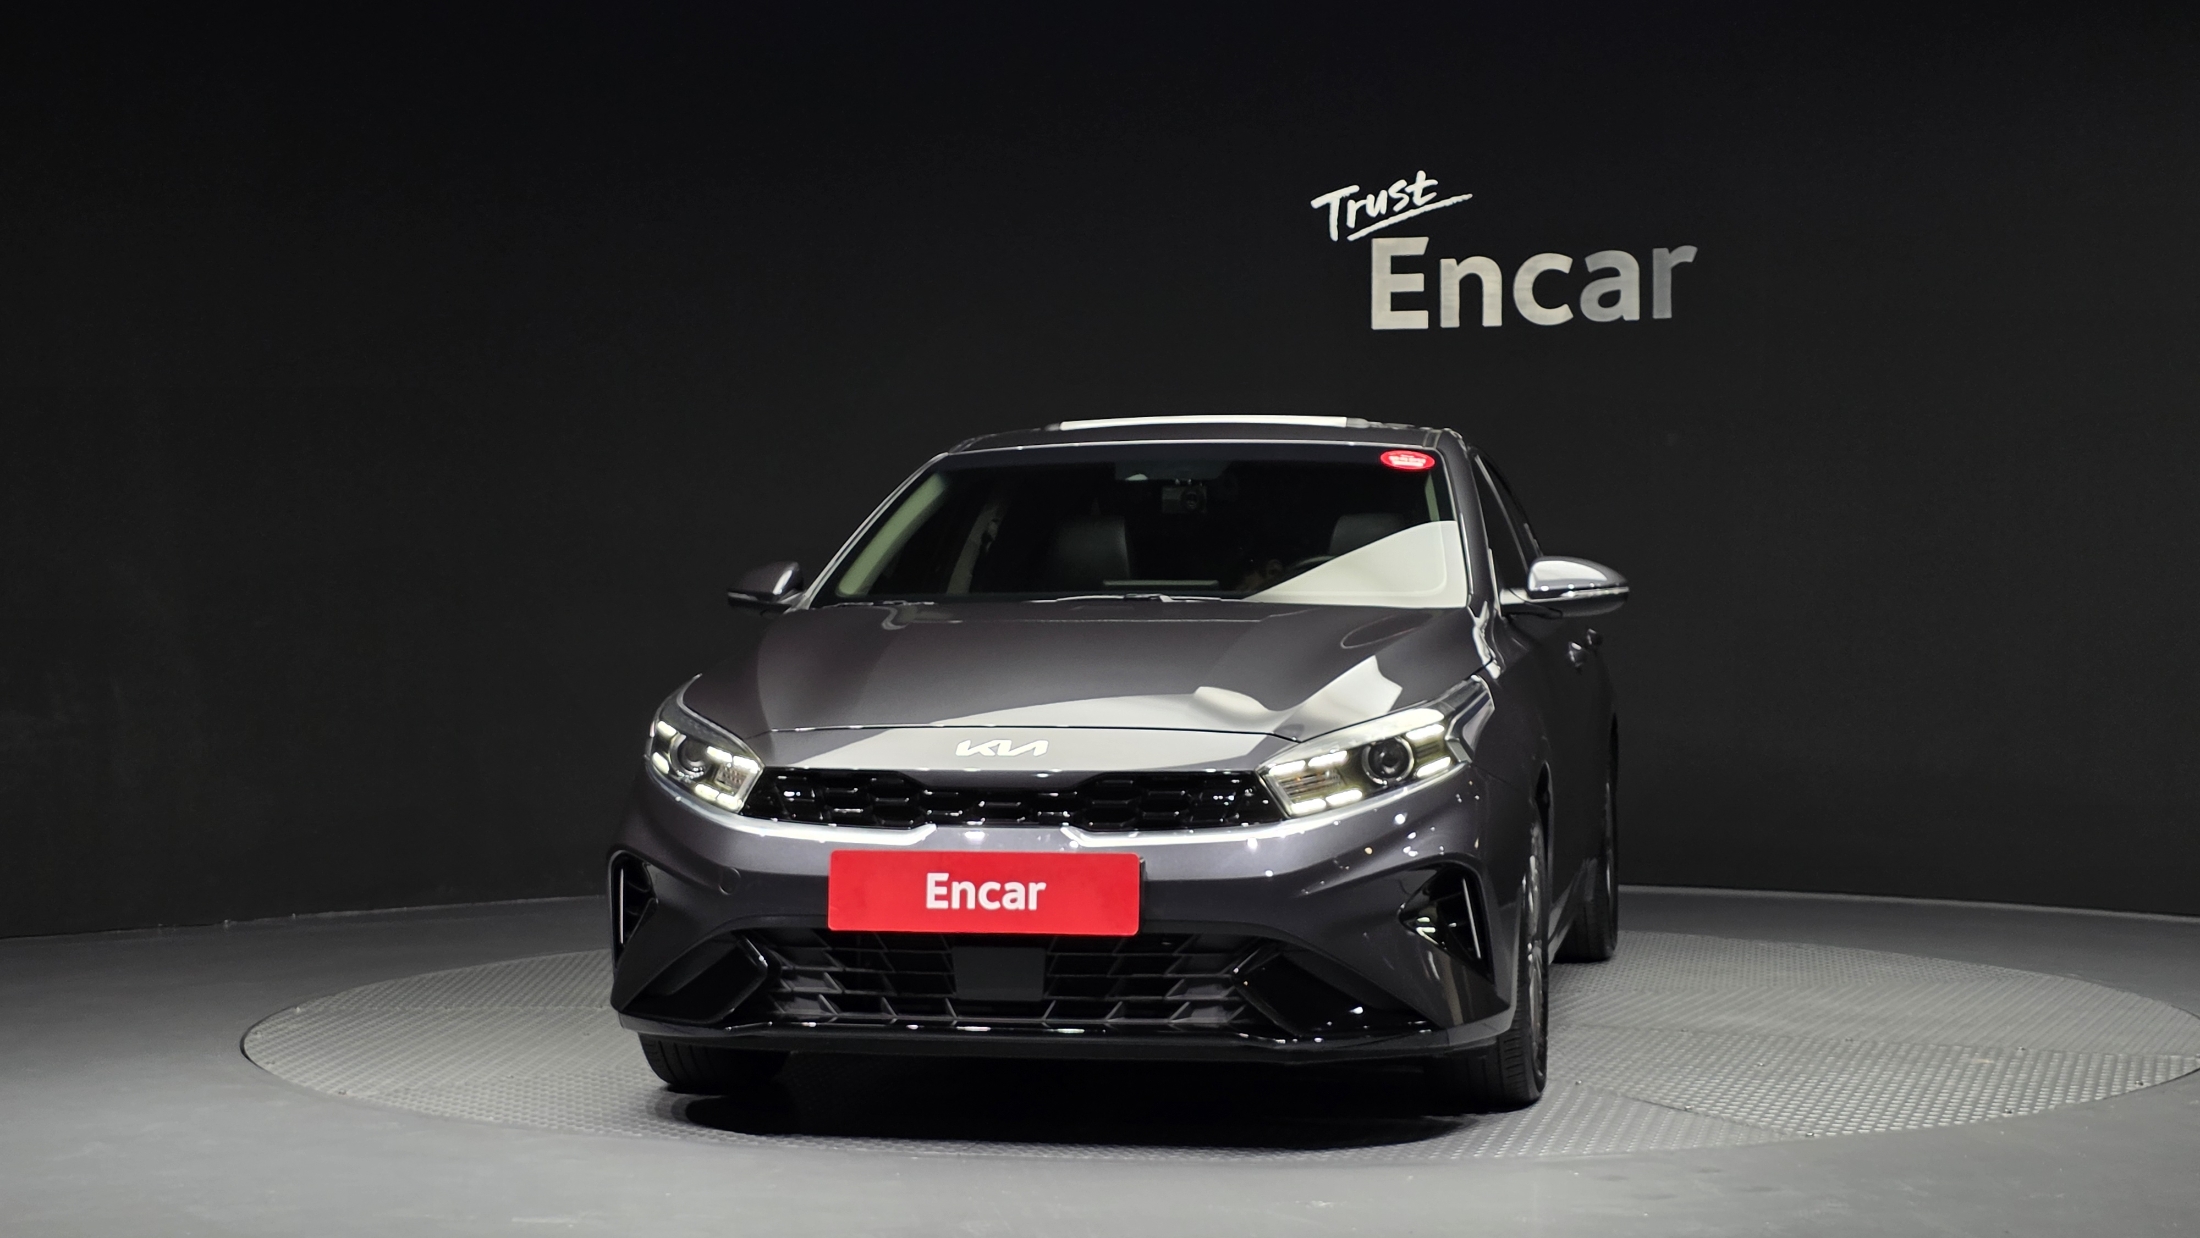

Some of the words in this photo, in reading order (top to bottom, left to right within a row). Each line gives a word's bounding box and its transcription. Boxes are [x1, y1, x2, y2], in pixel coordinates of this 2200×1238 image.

[1311, 170, 1438, 241] Trust
[1371, 236, 1698, 330] Encar
[955, 740, 1049, 757] KIA
[926, 872, 1047, 910] Encar
